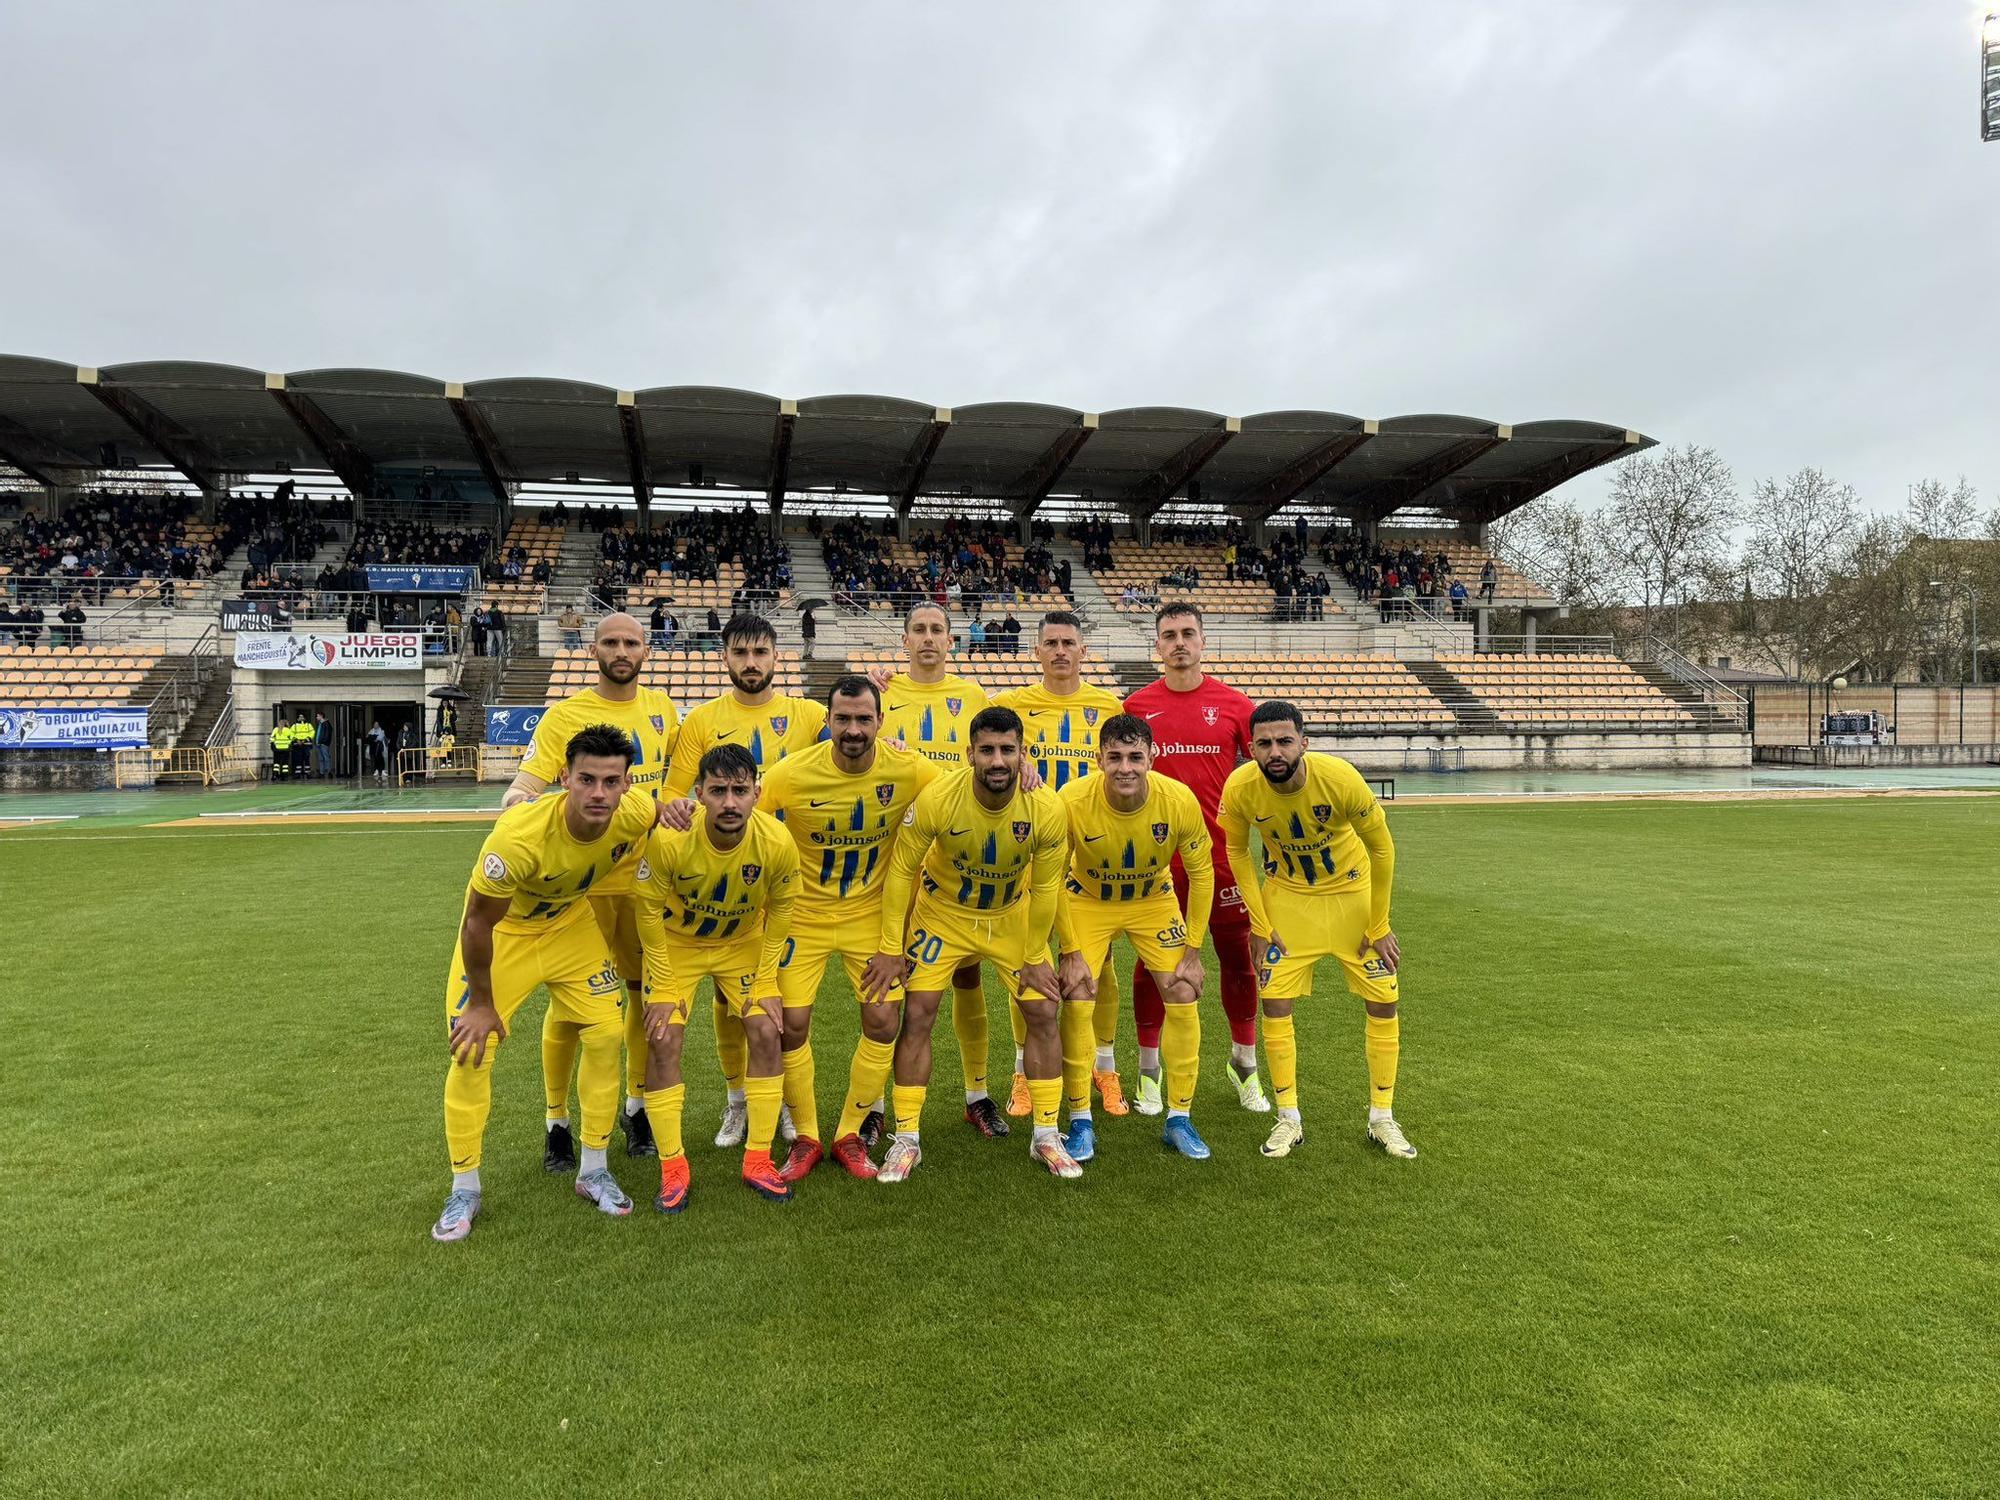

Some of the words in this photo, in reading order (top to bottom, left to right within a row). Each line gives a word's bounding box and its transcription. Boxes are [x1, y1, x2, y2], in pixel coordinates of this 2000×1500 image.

[247, 641, 272, 652] FRENTE
[340, 635, 417, 647] JUEGO
[237, 649, 287, 662] MANCHEGUISTA
[341, 647, 417, 658] LIMPIO
[45, 711, 100, 726] ORGULLO
[58, 722, 142, 738] BLANQUIAZUL
[1042, 745, 1095, 758] johnson
[1162, 742, 1220, 757] johnson
[827, 830, 889, 846] johnson
[692, 904, 755, 917] johnson
[907, 929, 943, 963] 20
